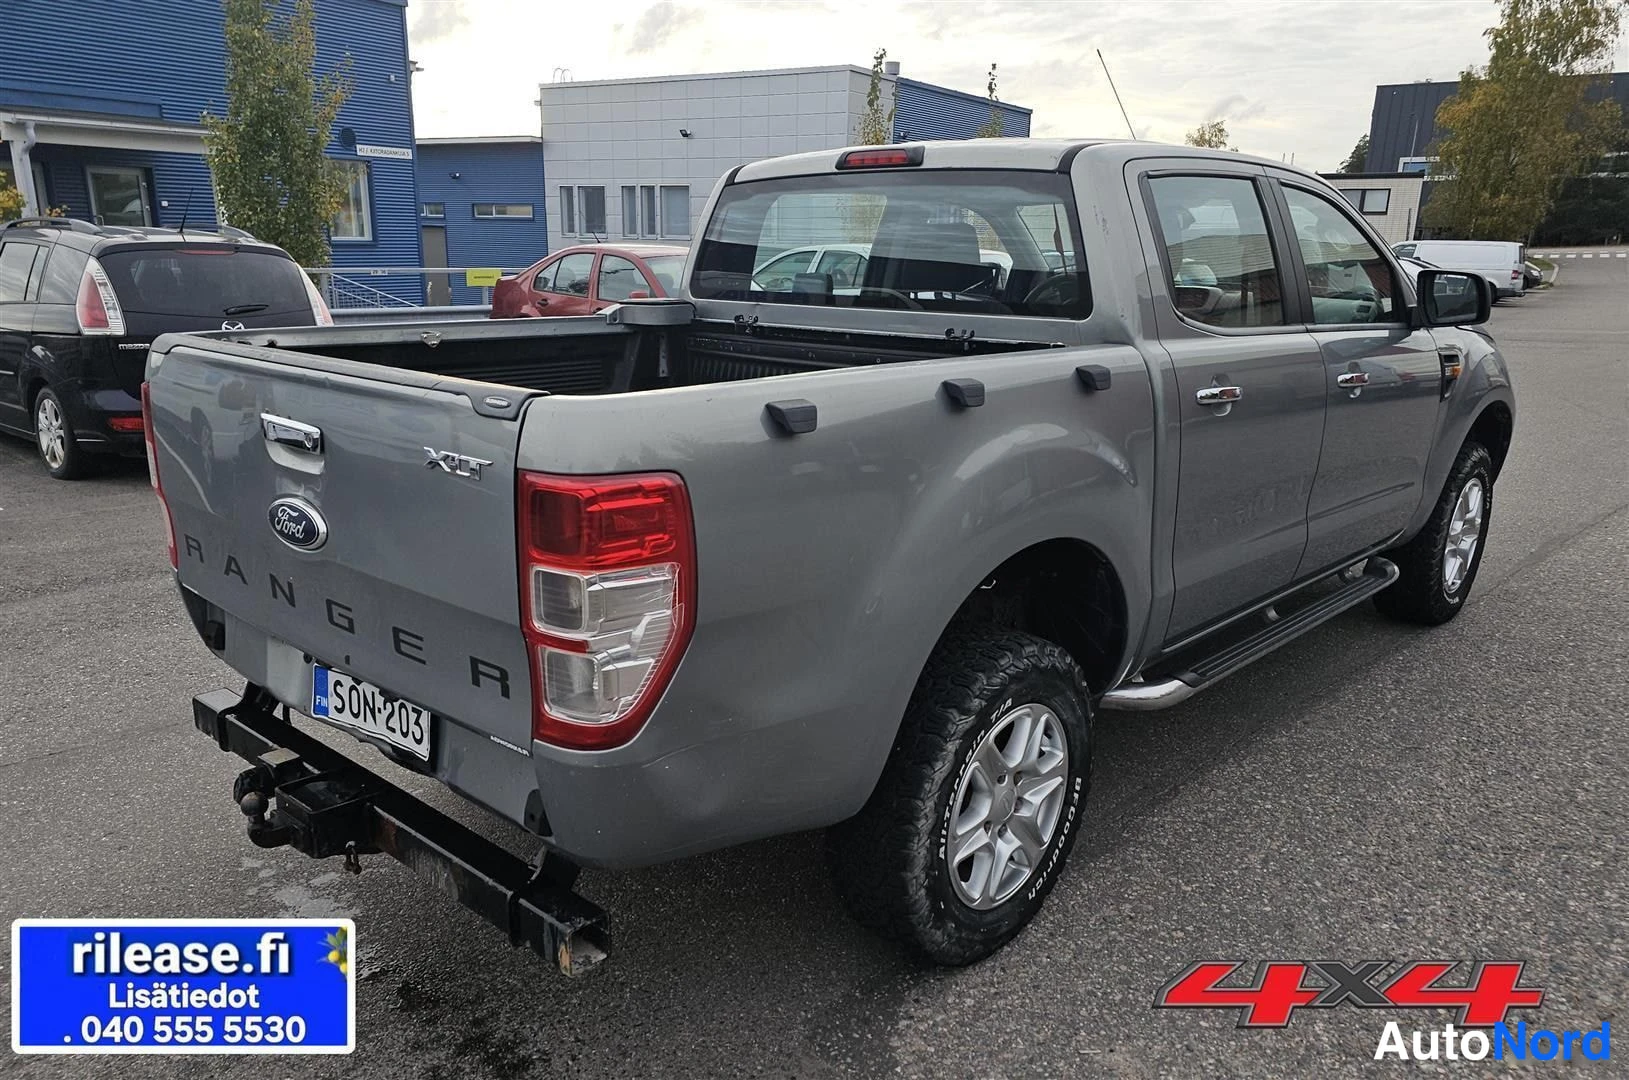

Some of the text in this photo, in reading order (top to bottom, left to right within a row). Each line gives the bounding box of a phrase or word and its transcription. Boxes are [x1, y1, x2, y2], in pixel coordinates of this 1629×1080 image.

[424, 446, 493, 480] XLT
[273, 506, 305, 539] Ford
[184, 533, 510, 699] RANGER
[316, 695, 328, 708] FIN
[333, 680, 424, 745] SON-203
[1028, 777, 1081, 900] BFGoodrich
